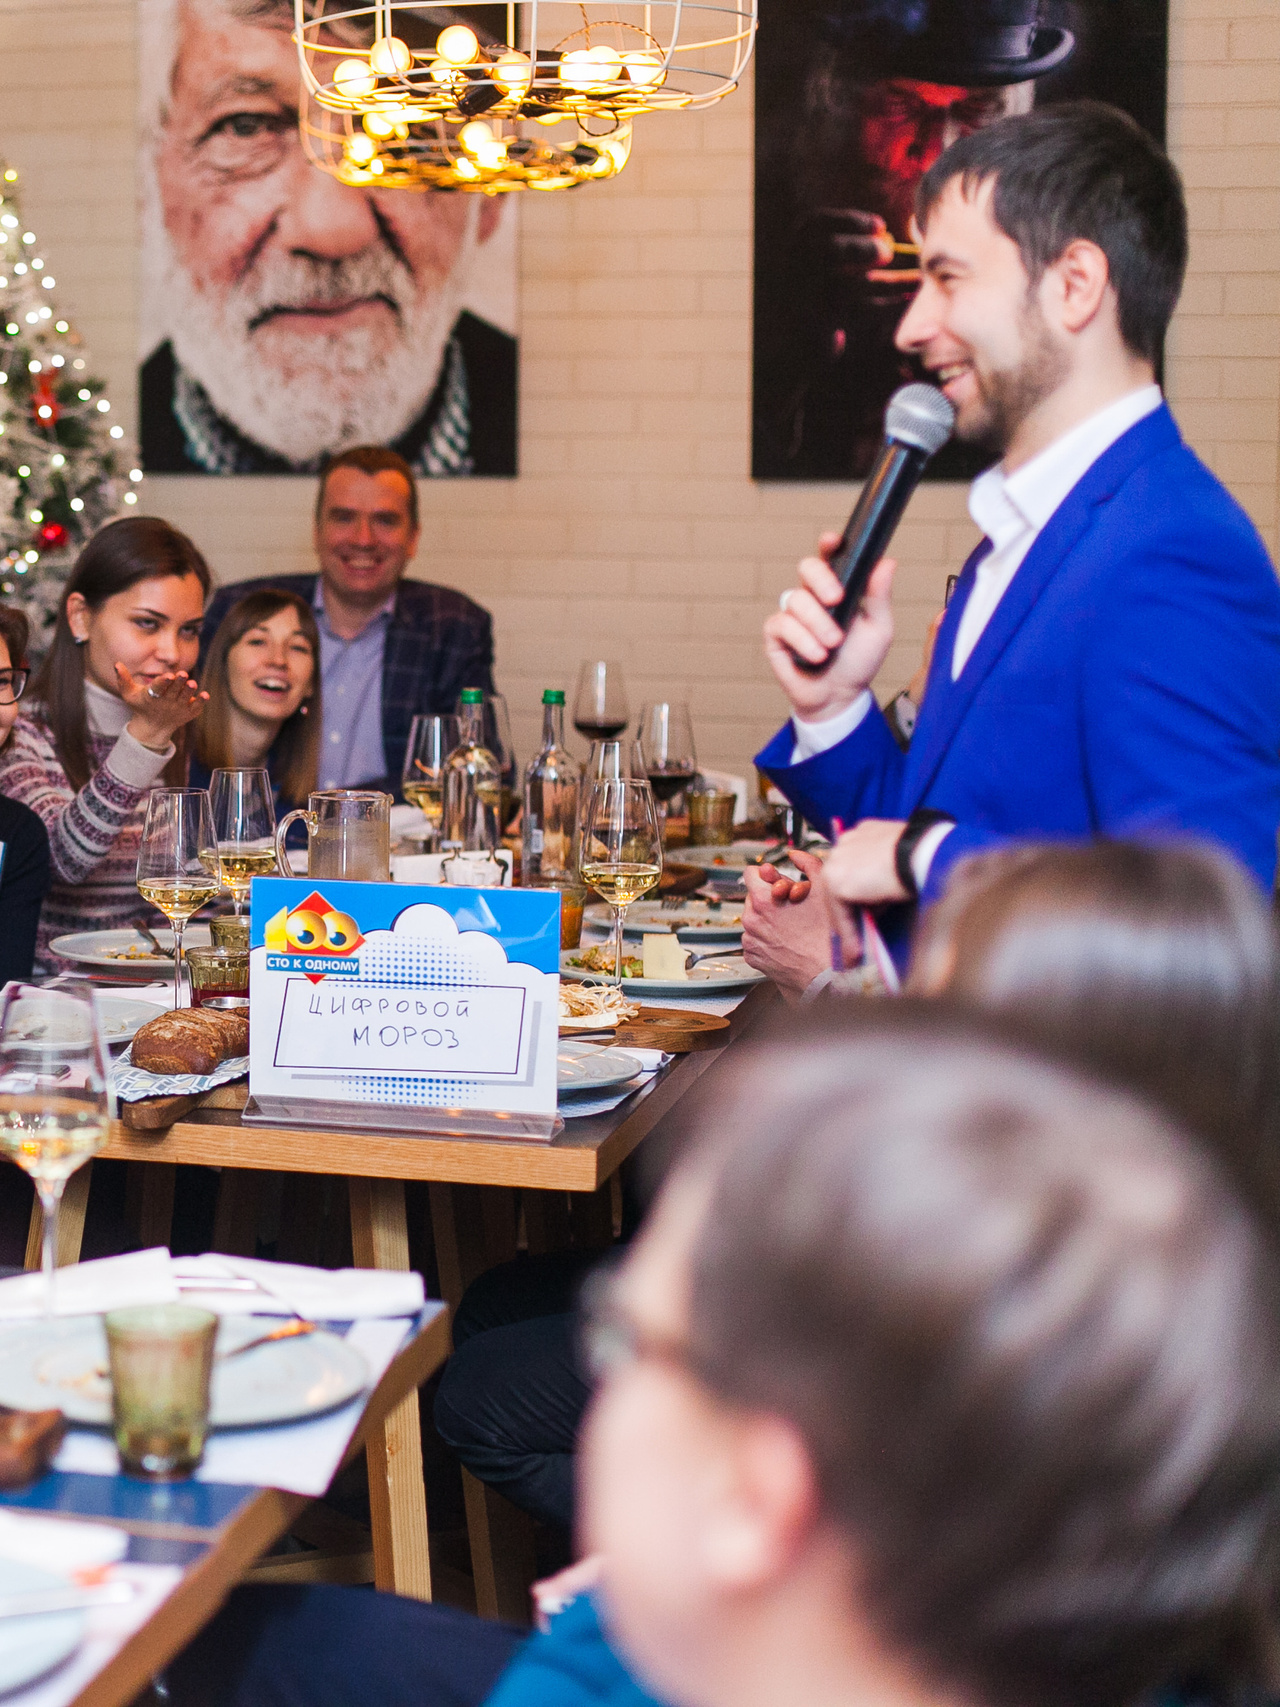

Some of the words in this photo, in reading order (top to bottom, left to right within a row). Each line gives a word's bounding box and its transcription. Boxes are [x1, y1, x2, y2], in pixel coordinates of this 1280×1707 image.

[267, 957, 290, 968] СТО
[293, 958, 302, 969] К
[304, 959, 359, 972] ОДНОМУ
[308, 993, 470, 1018] ЦИФРОВОЙ
[353, 1025, 460, 1049] МОРОЗ
